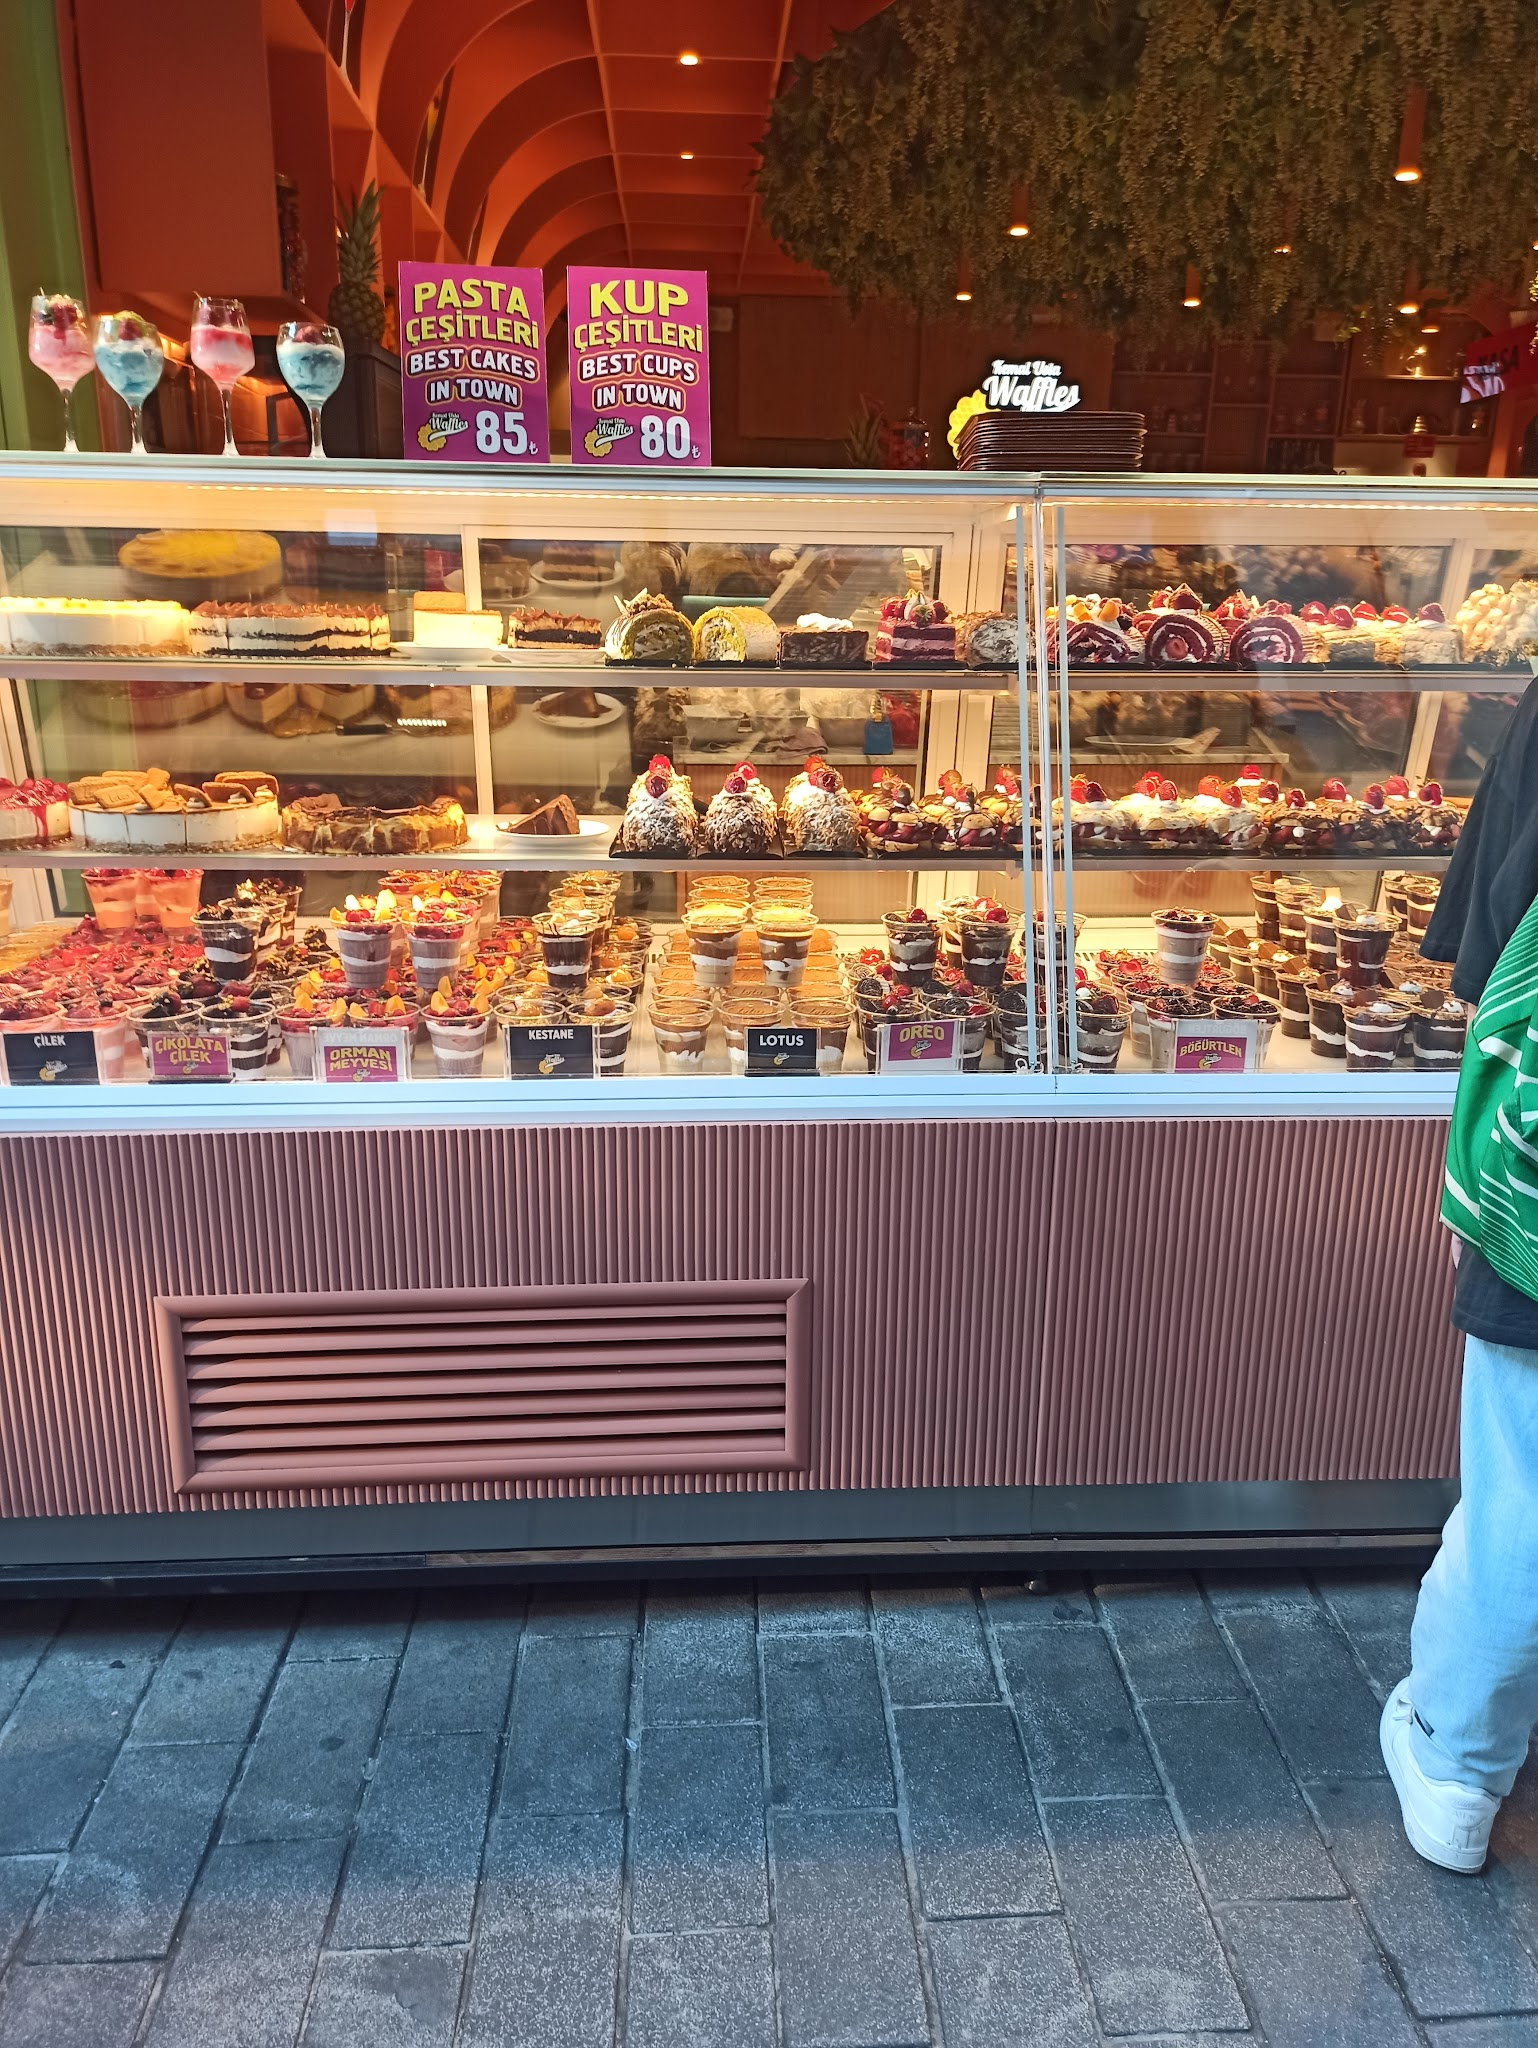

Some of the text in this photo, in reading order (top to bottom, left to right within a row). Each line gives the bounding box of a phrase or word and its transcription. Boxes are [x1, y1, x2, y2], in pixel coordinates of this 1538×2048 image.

[414, 278, 530, 320] PASTA
[590, 279, 689, 318] KUP
[405, 309, 539, 349] ÇEŞİTLERİ
[574, 315, 703, 353] ÇEŞİTLERİ
[410, 349, 536, 379] BEST CAKES
[582, 353, 695, 382] BEST CUPS
[430, 379, 518, 406] IN TOWN
[596, 384, 682, 410] IN TOWN
[982, 375, 1079, 411] Waffles
[429, 417, 468, 432] Waffles
[596, 423, 633, 437] Waffles
[34, 1034, 66, 1048] ÇİLEK
[529, 1029, 574, 1040] KESTANE
[759, 1034, 804, 1047] LOTUS
[899, 1024, 945, 1043] OREO
[329, 1047, 391, 1061] ORMAN
